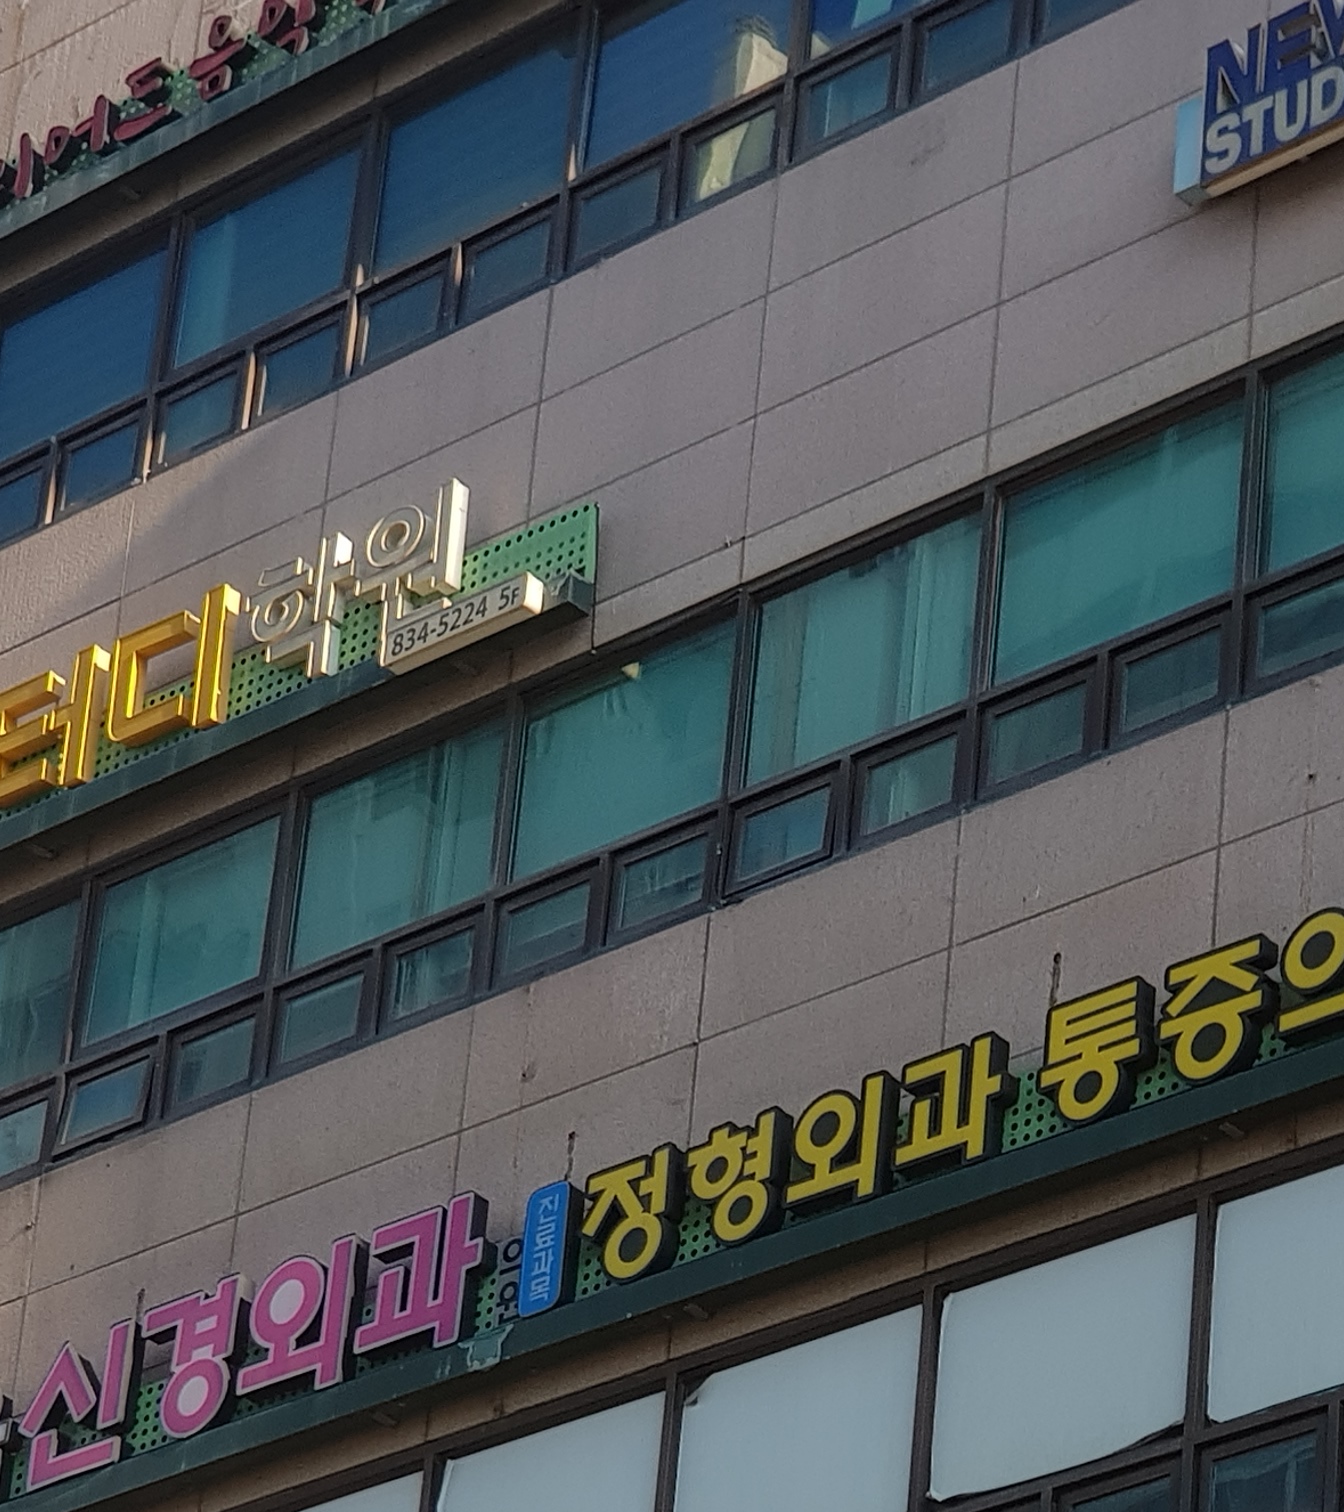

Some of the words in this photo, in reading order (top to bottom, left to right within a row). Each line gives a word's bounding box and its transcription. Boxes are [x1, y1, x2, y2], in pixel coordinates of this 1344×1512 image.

[390, 598, 490, 659] 834-5224
[498, 586, 521, 611] 5F
[580, 1031, 1012, 1284] 정형외과
[19, 1192, 484, 1491] 신경외과
